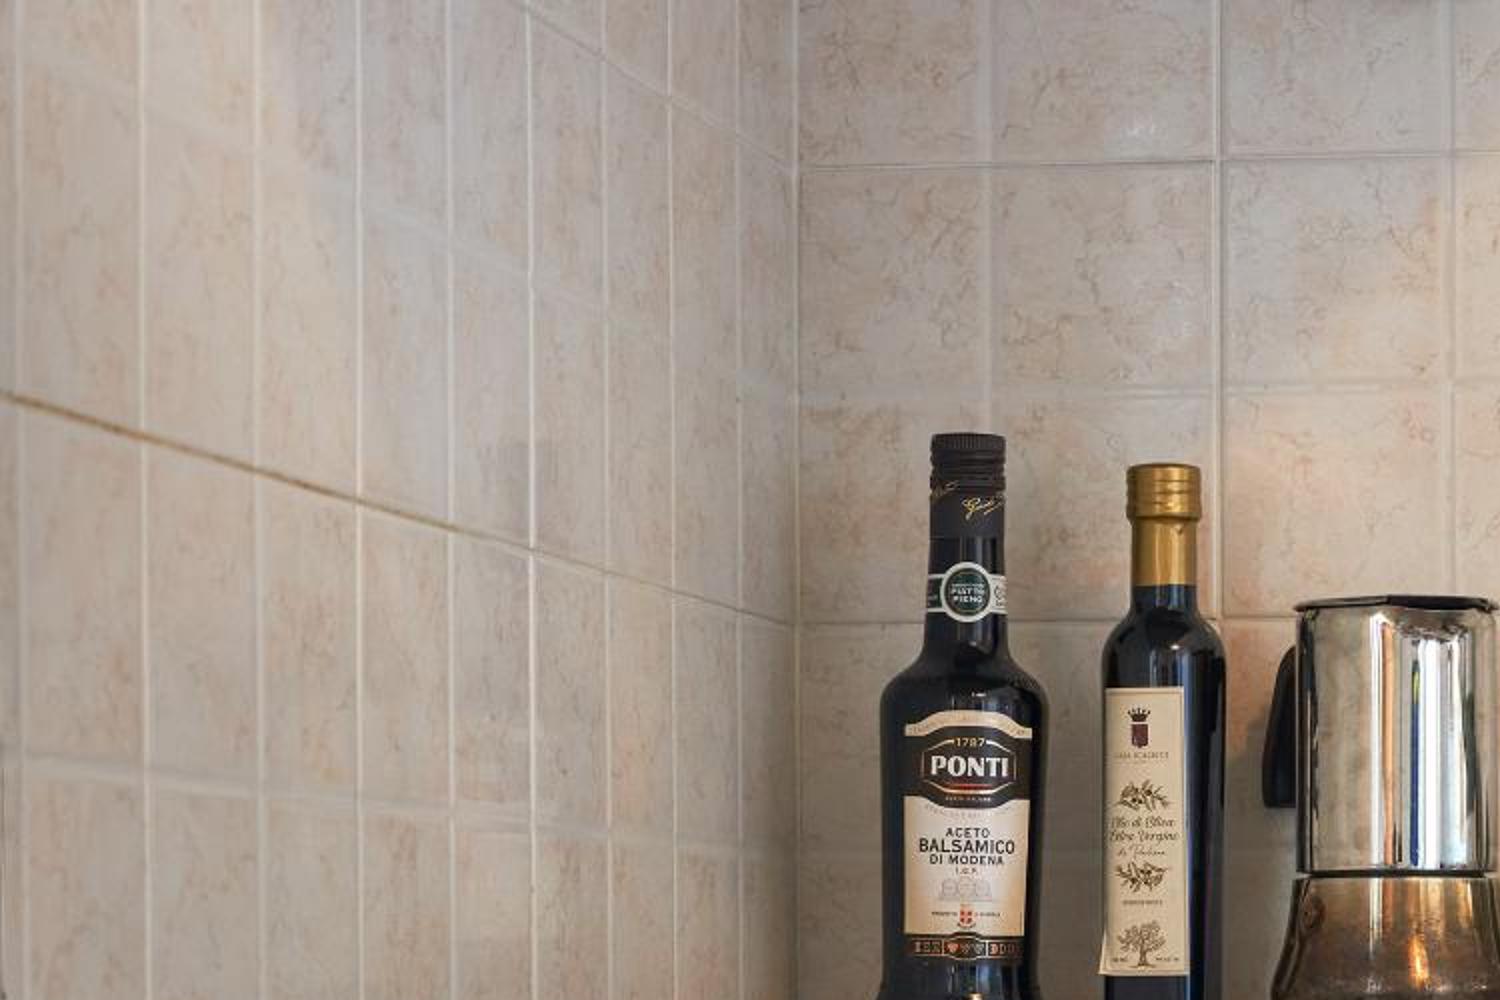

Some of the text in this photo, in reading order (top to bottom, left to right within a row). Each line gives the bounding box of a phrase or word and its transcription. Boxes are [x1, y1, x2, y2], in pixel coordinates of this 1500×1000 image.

[956, 738, 985, 747] 1787
[931, 755, 1009, 777] PONTI
[945, 827, 990, 838] ACETO
[919, 838, 1015, 854] BALSAMICO
[929, 853, 1005, 865] DI MODENA
